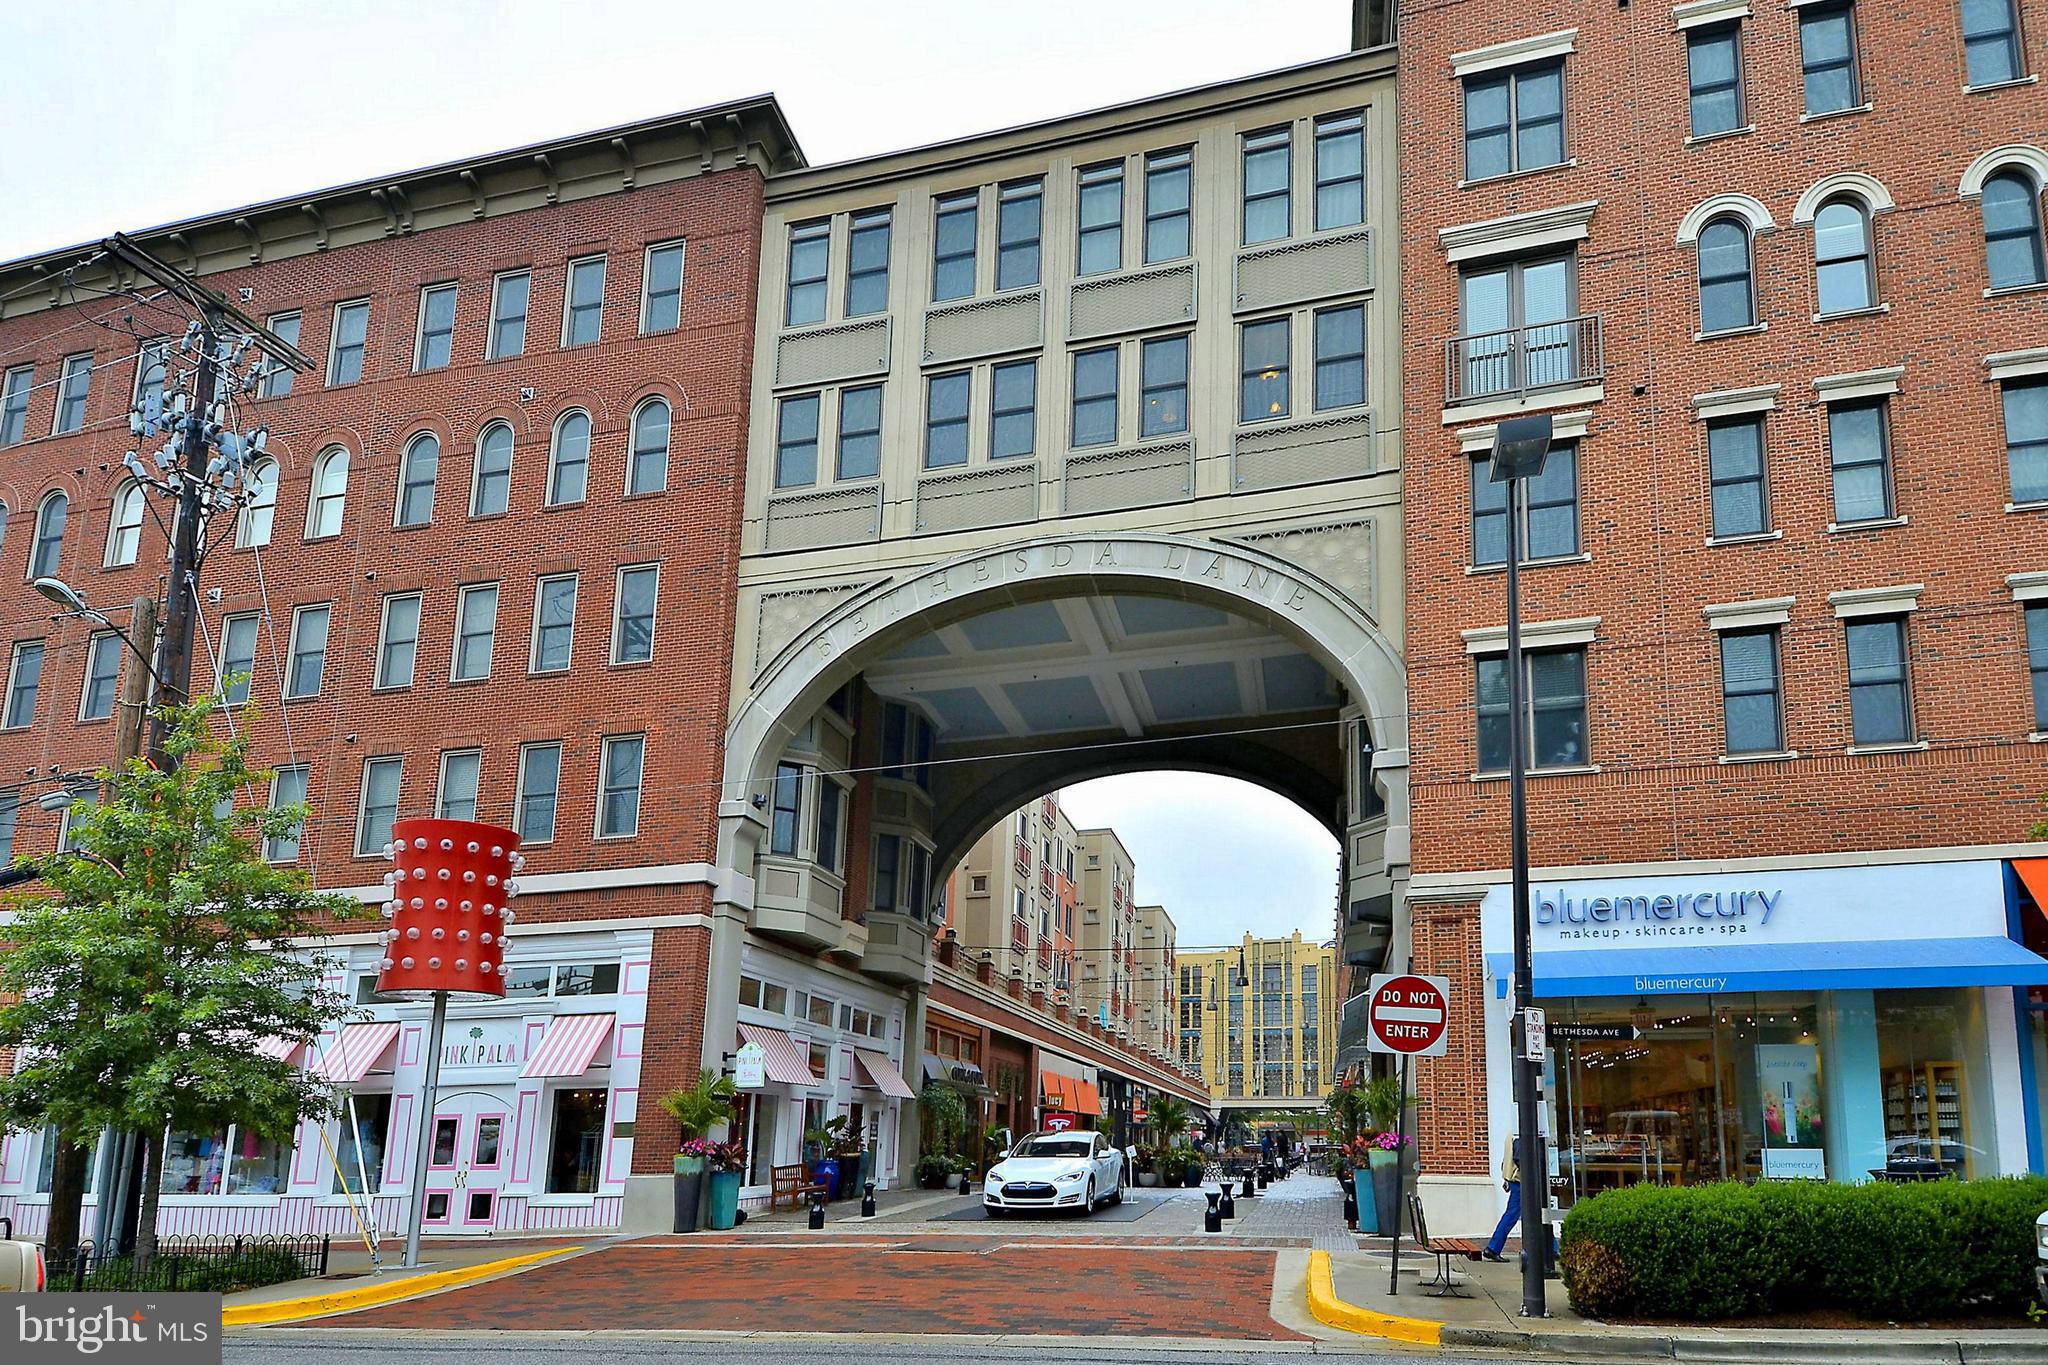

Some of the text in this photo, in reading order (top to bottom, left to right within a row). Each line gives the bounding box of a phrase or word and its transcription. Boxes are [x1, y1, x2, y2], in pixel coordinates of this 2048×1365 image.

[812, 542, 1312, 657] BETHESDA LANE
[1536, 889, 1782, 925] bluemercury
[1560, 923, 1747, 940] makeup skincare spa
[1634, 976, 1727, 991] bluemercury
[1382, 990, 1436, 1005] DO NOT
[1385, 1024, 1429, 1039] ENTER
[1552, 1028, 1620, 1037] BETHESDA AVE
[477, 1043, 515, 1063] PALM
[1768, 1160, 1820, 1171] bluemercury
